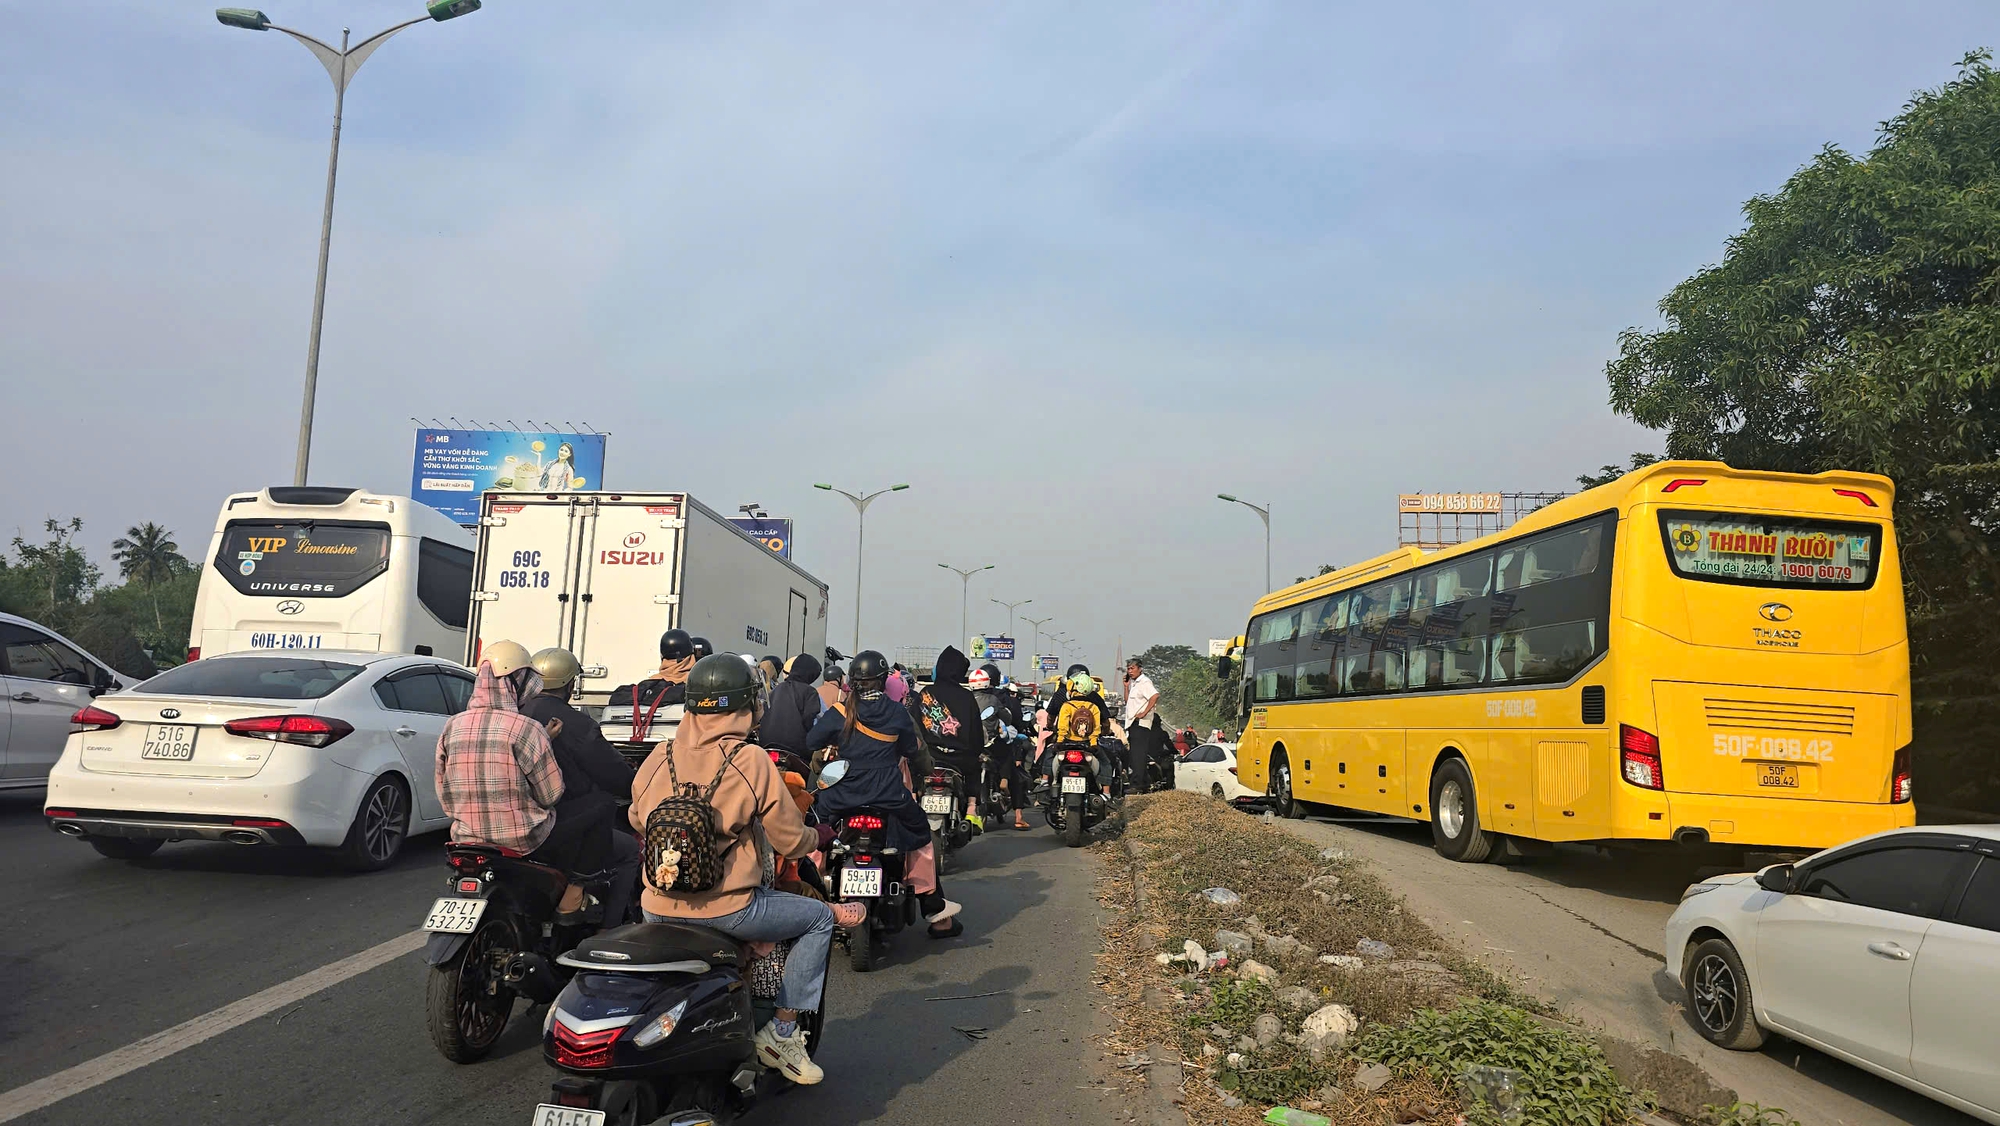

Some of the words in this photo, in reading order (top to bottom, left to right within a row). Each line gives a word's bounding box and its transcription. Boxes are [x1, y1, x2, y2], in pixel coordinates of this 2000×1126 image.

[1423, 495, 1444, 510] 094
[1446, 495, 1468, 510] 858
[1470, 495, 1484, 510] 66
[1486, 495, 1500, 510] 22
[248, 537, 287, 553] VIP
[294, 538, 358, 555] Limousine
[1682, 533, 1692, 544] B
[1708, 528, 1778, 555] THÀNH
[1786, 532, 1835, 558] BƯỞI
[512, 550, 542, 568] 69C
[600, 550, 664, 566] ISUZU
[1693, 558, 1720, 573] Tổng
[1723, 561, 1739, 573] đài
[1744, 563, 1777, 575] 24/24:
[1780, 563, 1814, 578] 1900
[1818, 565, 1852, 580] 6079
[500, 570, 550, 588] 058.18
[250, 582, 335, 592] UNIVERSE
[251, 632, 322, 649] 60H-120.11
[1752, 628, 1802, 640] THACO
[162, 710, 178, 718] KIA
[1486, 698, 1536, 718] 50F-008.42
[158, 726, 184, 742] 51G
[146, 742, 190, 758] 740.86
[1713, 734, 1834, 762] 50F-008.42
[1768, 766, 1786, 775] 50F
[1763, 776, 1794, 786] 008.42
[847, 870, 876, 882] 59-V3
[844, 883, 878, 895] 444.49
[439, 901, 477, 915] 70-L1
[427, 915, 476, 930] 532.75
